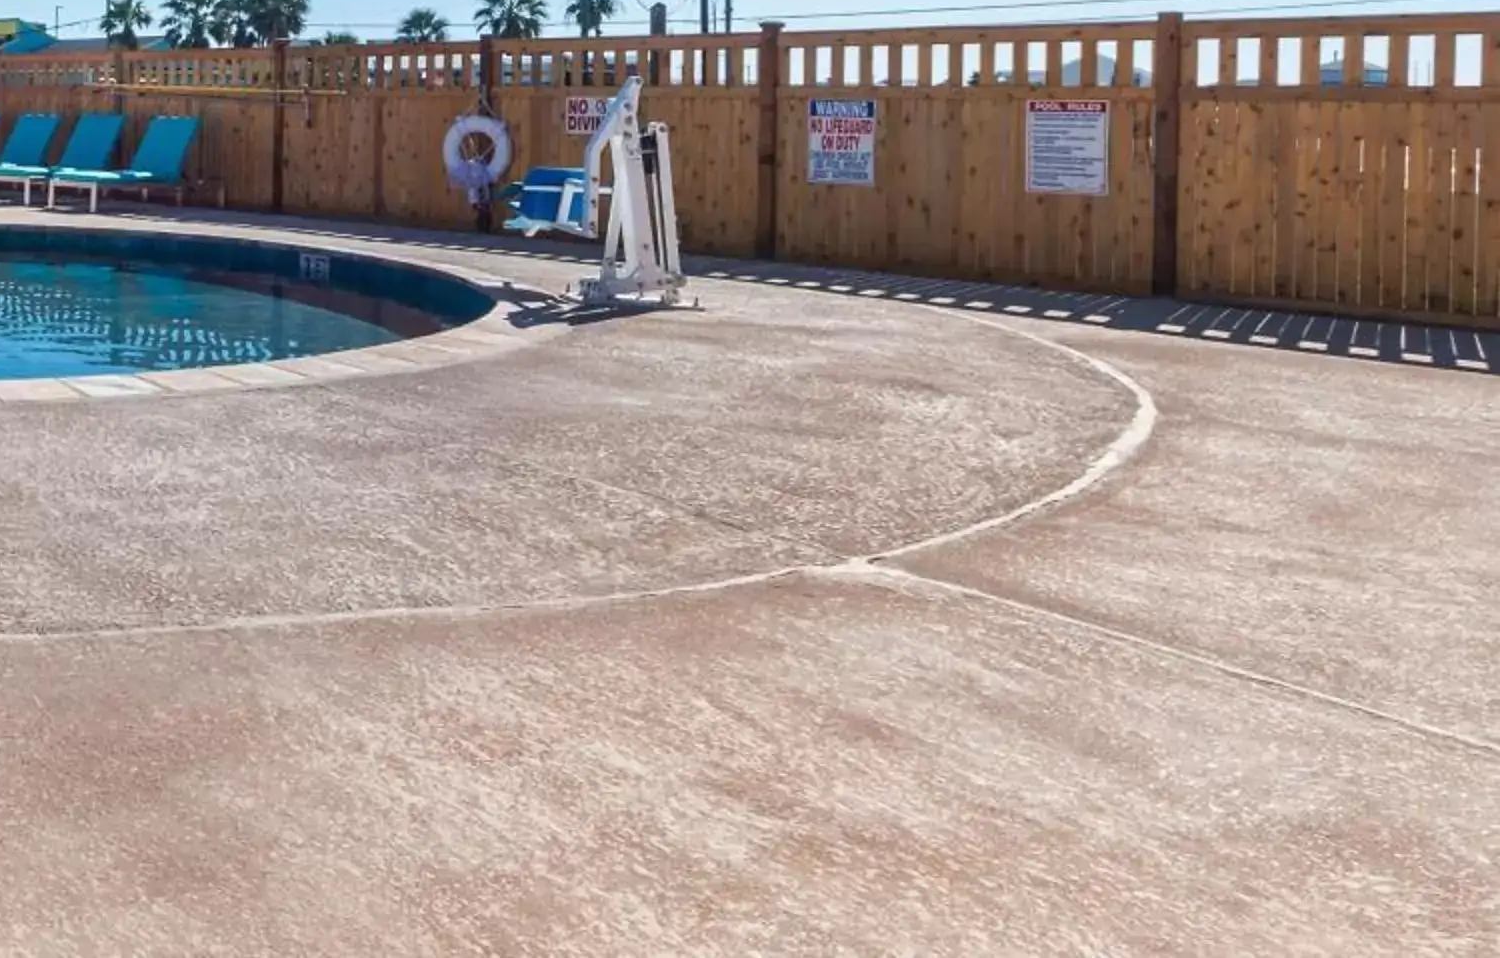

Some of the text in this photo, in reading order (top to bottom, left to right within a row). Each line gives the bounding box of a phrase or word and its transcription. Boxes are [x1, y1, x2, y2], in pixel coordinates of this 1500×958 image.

[568, 100, 588, 115] NO
[815, 101, 869, 117] WARNING
[810, 118, 822, 133] NO
[822, 135, 859, 151] ON DUTY
